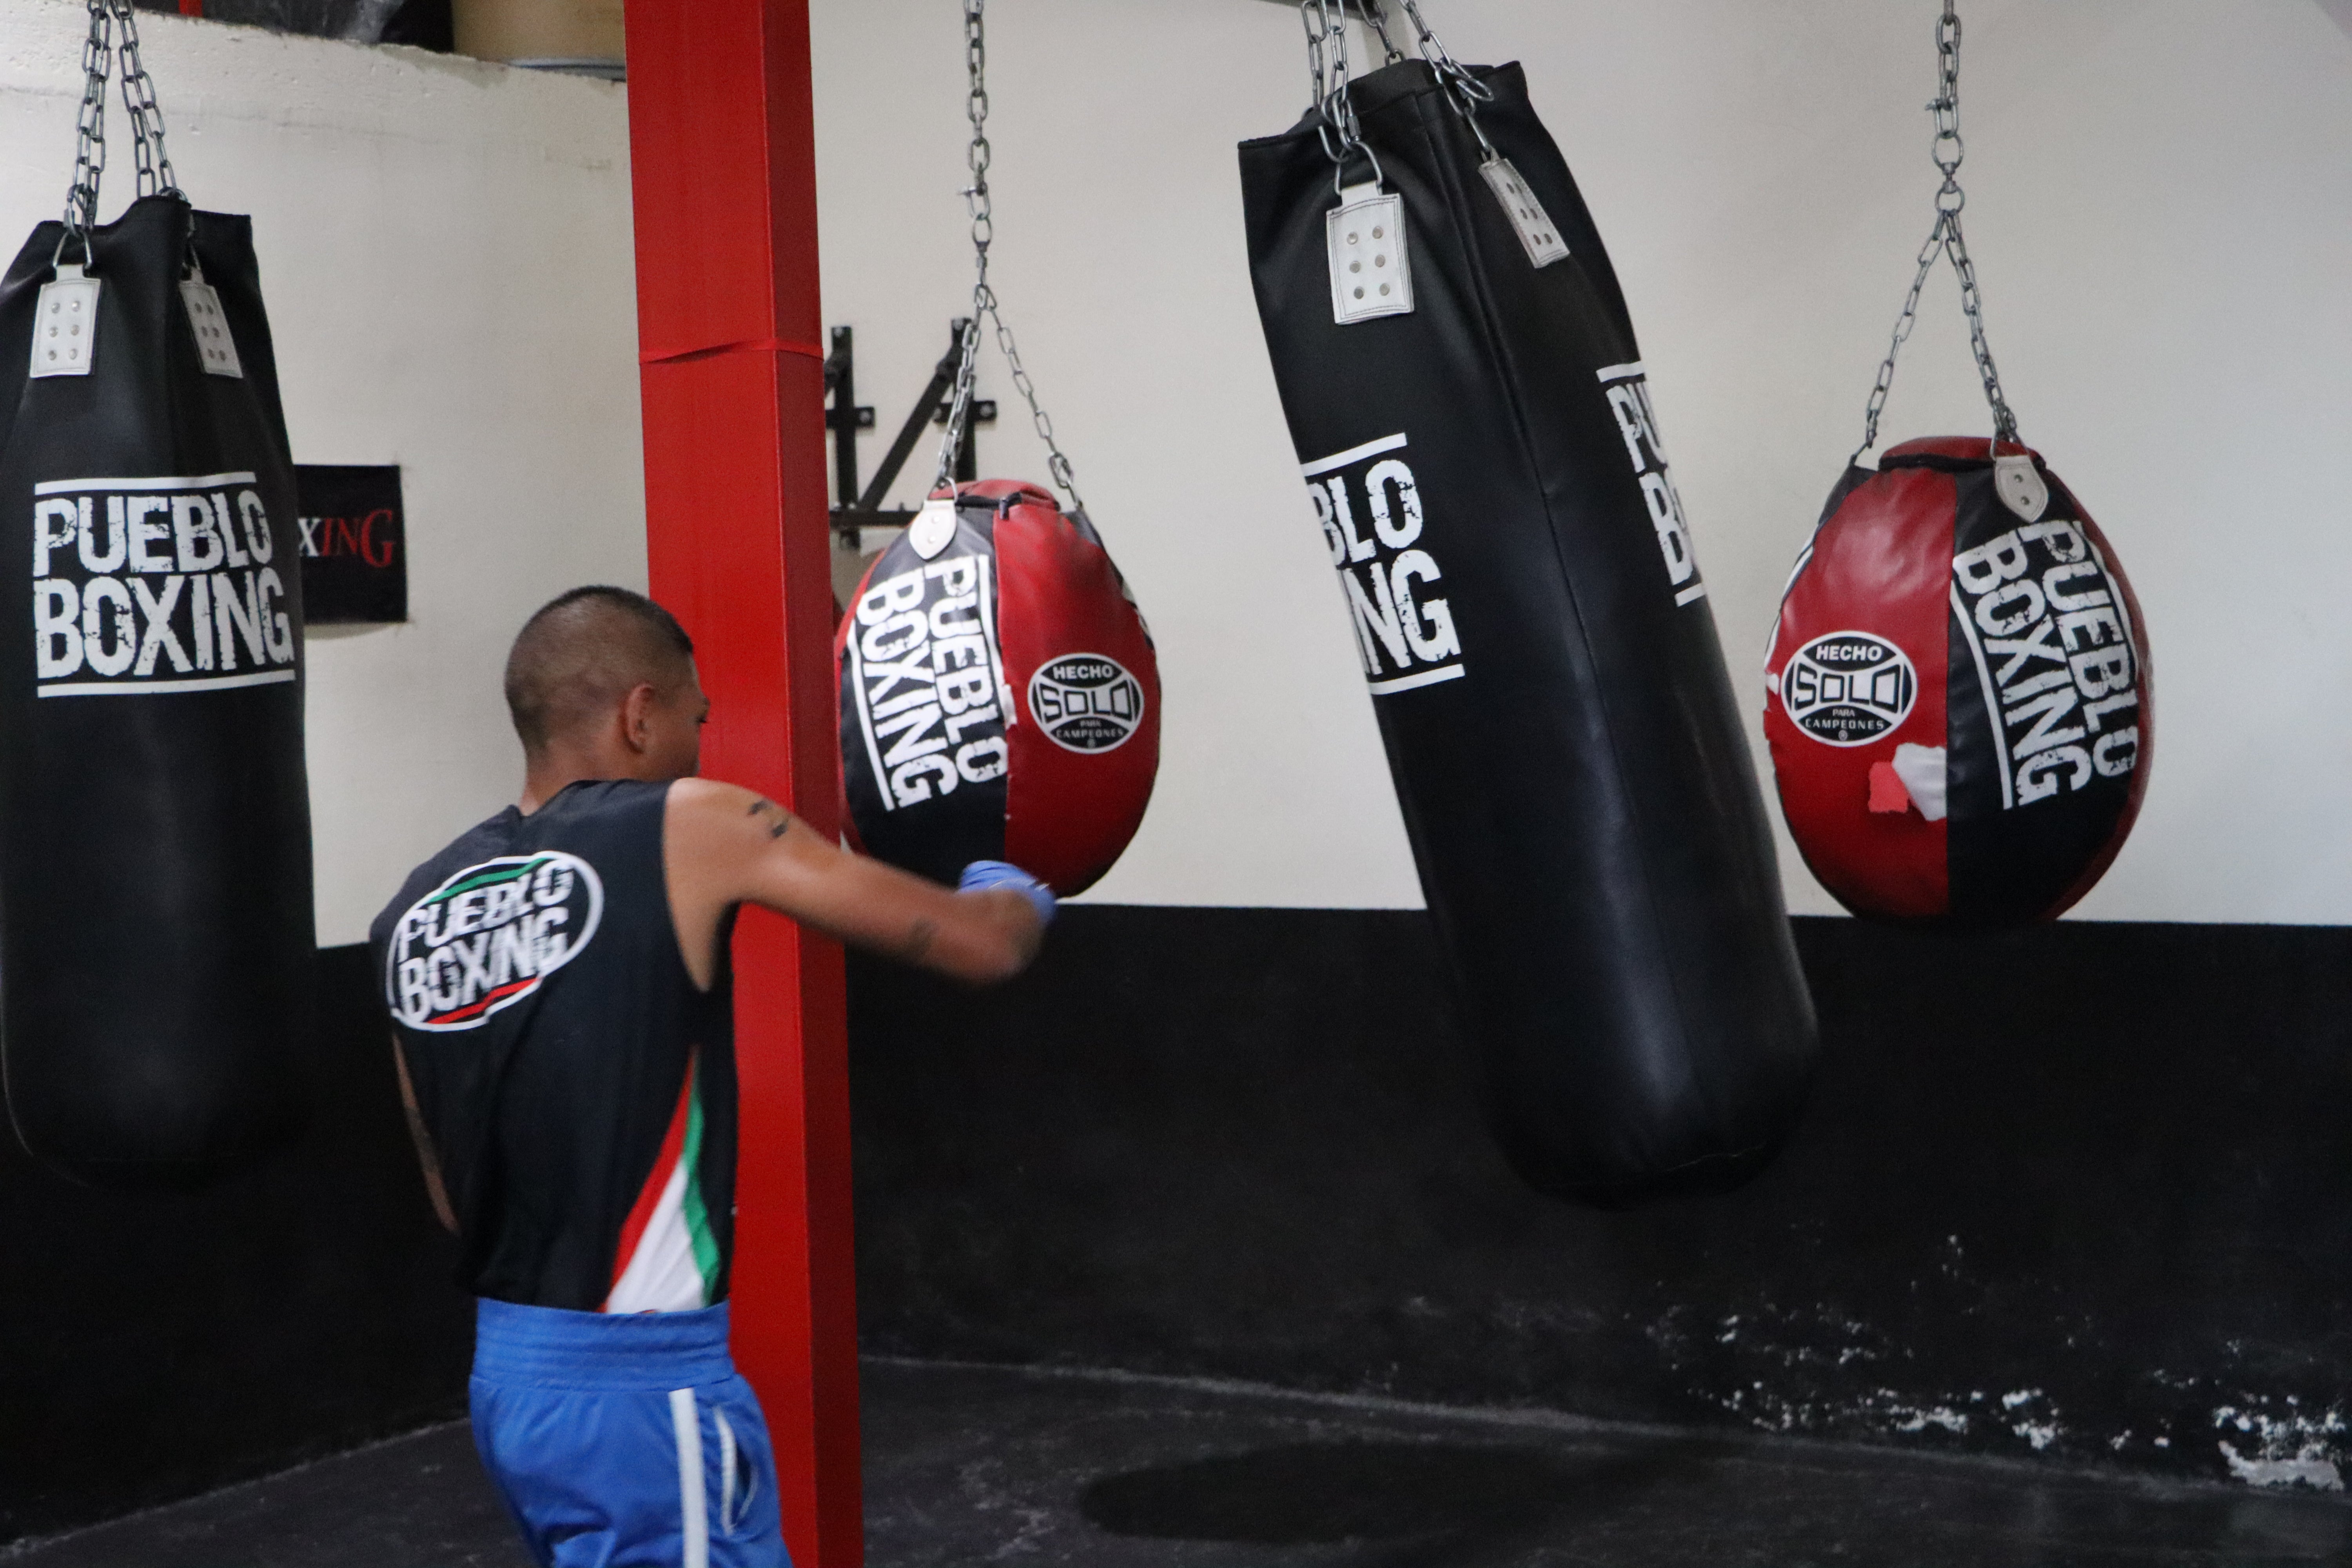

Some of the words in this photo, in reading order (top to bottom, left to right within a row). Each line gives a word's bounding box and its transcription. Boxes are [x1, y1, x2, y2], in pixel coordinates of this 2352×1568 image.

[33, 490, 272, 577] PUEBLO
[298, 509, 395, 568] XING
[34, 567, 294, 679] BOXING
[1338, 550, 1461, 675] NG
[1816, 646, 1882, 661] HECHO
[2017, 520, 2139, 777] PUEBLO
[856, 567, 959, 808] BOXING
[924, 555, 1009, 783] PUEBLO
[1039, 680, 1132, 724] SOLO
[1053, 665, 1114, 680] HECHO
[1795, 662, 1900, 713] SOLO
[1953, 531, 2092, 806] BOXING
[1805, 718, 1884, 730] CAMPEONES
[398, 859, 574, 964] PUEBLO
[399, 906, 569, 1022] BOXING
